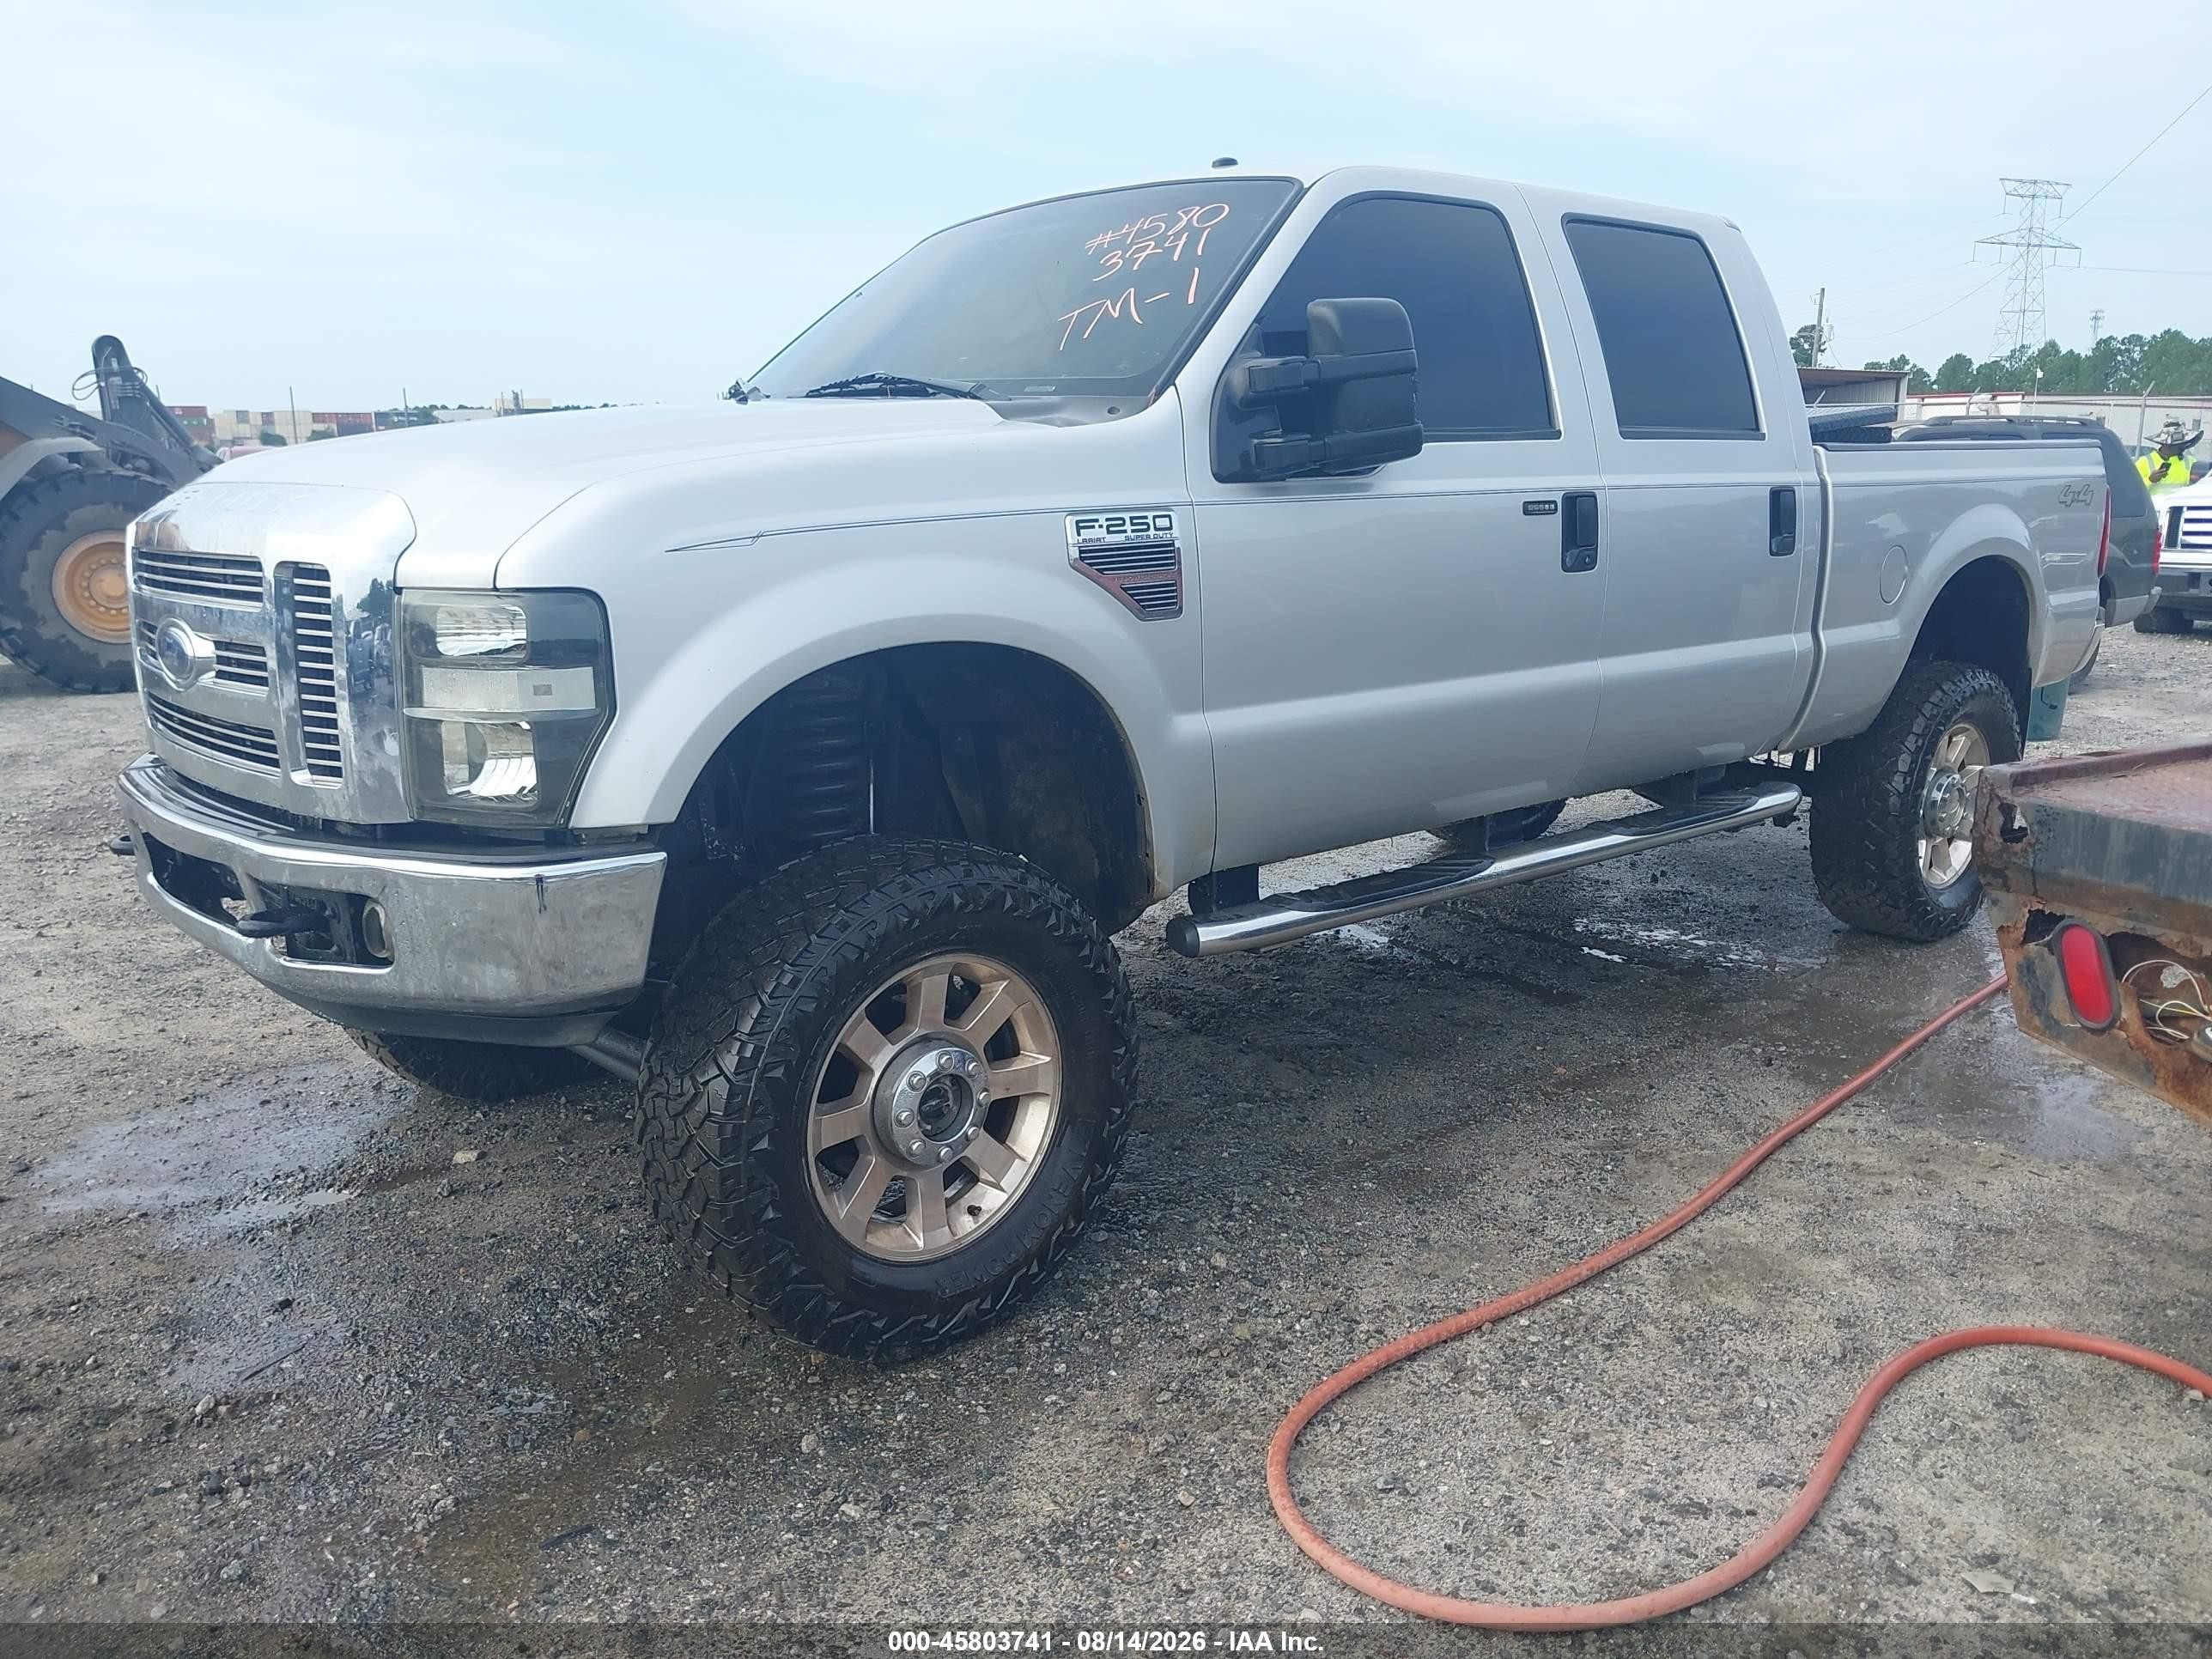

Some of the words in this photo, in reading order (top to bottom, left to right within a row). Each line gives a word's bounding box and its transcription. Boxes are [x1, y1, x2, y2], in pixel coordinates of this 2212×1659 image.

[1085, 204, 1230, 255] #4580
[1092, 227, 1211, 283] 3741
[2058, 483, 2095, 507] 4x4
[1075, 514, 1174, 537] F-250
[1124, 533, 1152, 542] SUPER
